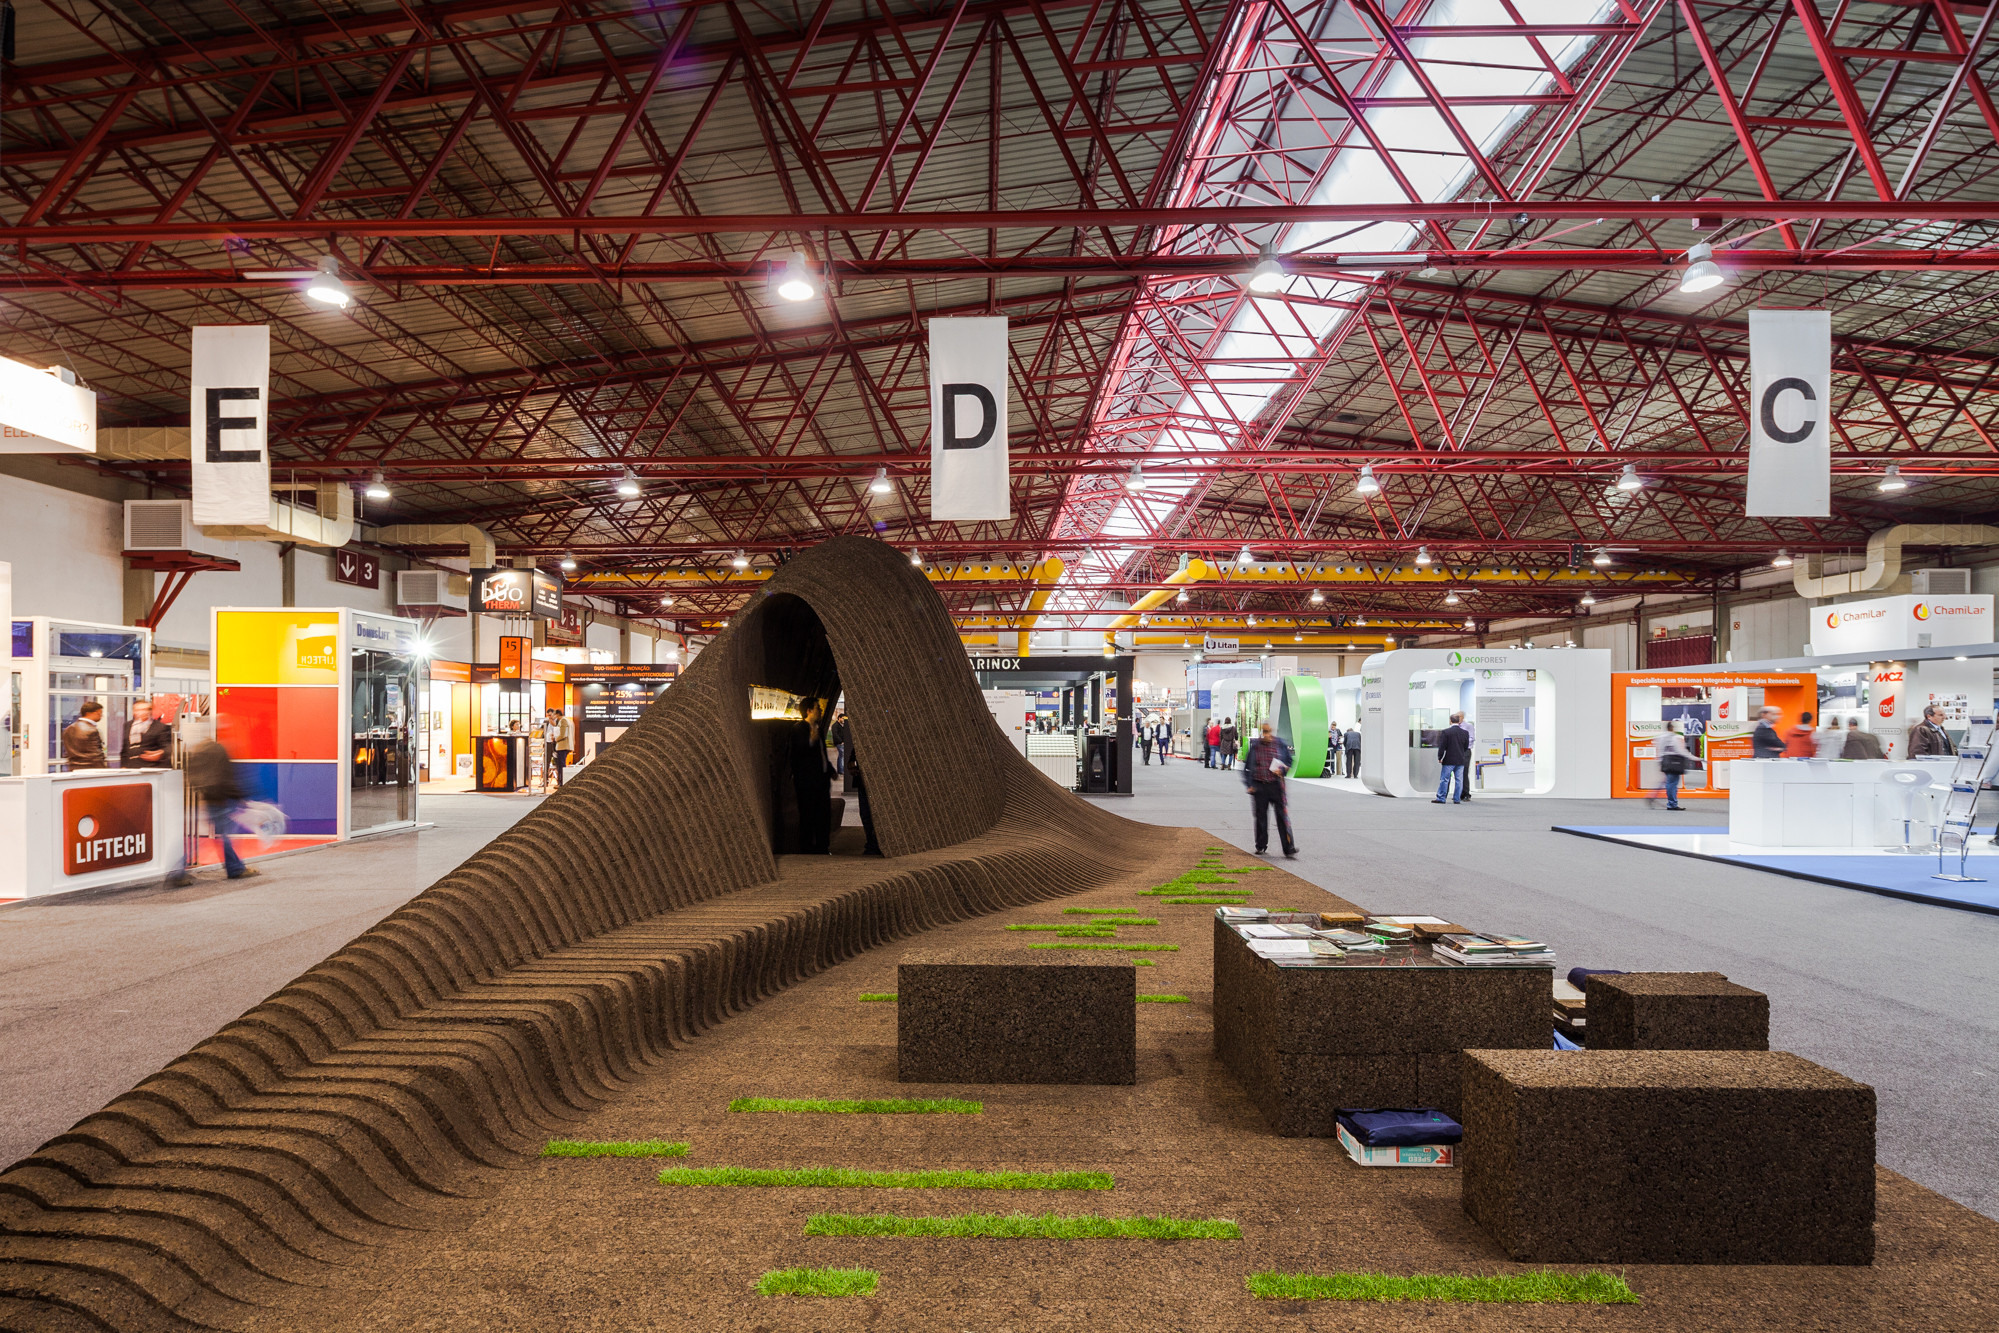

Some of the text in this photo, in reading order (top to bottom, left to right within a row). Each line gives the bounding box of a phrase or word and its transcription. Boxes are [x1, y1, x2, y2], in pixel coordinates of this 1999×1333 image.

[1762, 378, 1816, 443] C
[943, 384, 997, 449] D
[206, 388, 260, 462] E
[364, 562, 373, 581] 3
[485, 601, 520, 609] THERM
[1934, 605, 1986, 615] ChamiLar
[569, 614, 575, 627] 3
[1843, 609, 1887, 622] ChamiLar
[506, 641, 517, 652] 15
[1217, 641, 1237, 649] Litan
[1631, 677, 1666, 685] Especialistas
[1874, 672, 1904, 682] MCZ
[615, 690, 632, 698] 25%
[1719, 705, 1729, 715] red
[1880, 702, 1894, 714] red
[1641, 723, 1662, 731] solius
[1718, 723, 1740, 731] solius
[76, 833, 146, 864] LIFTECH
